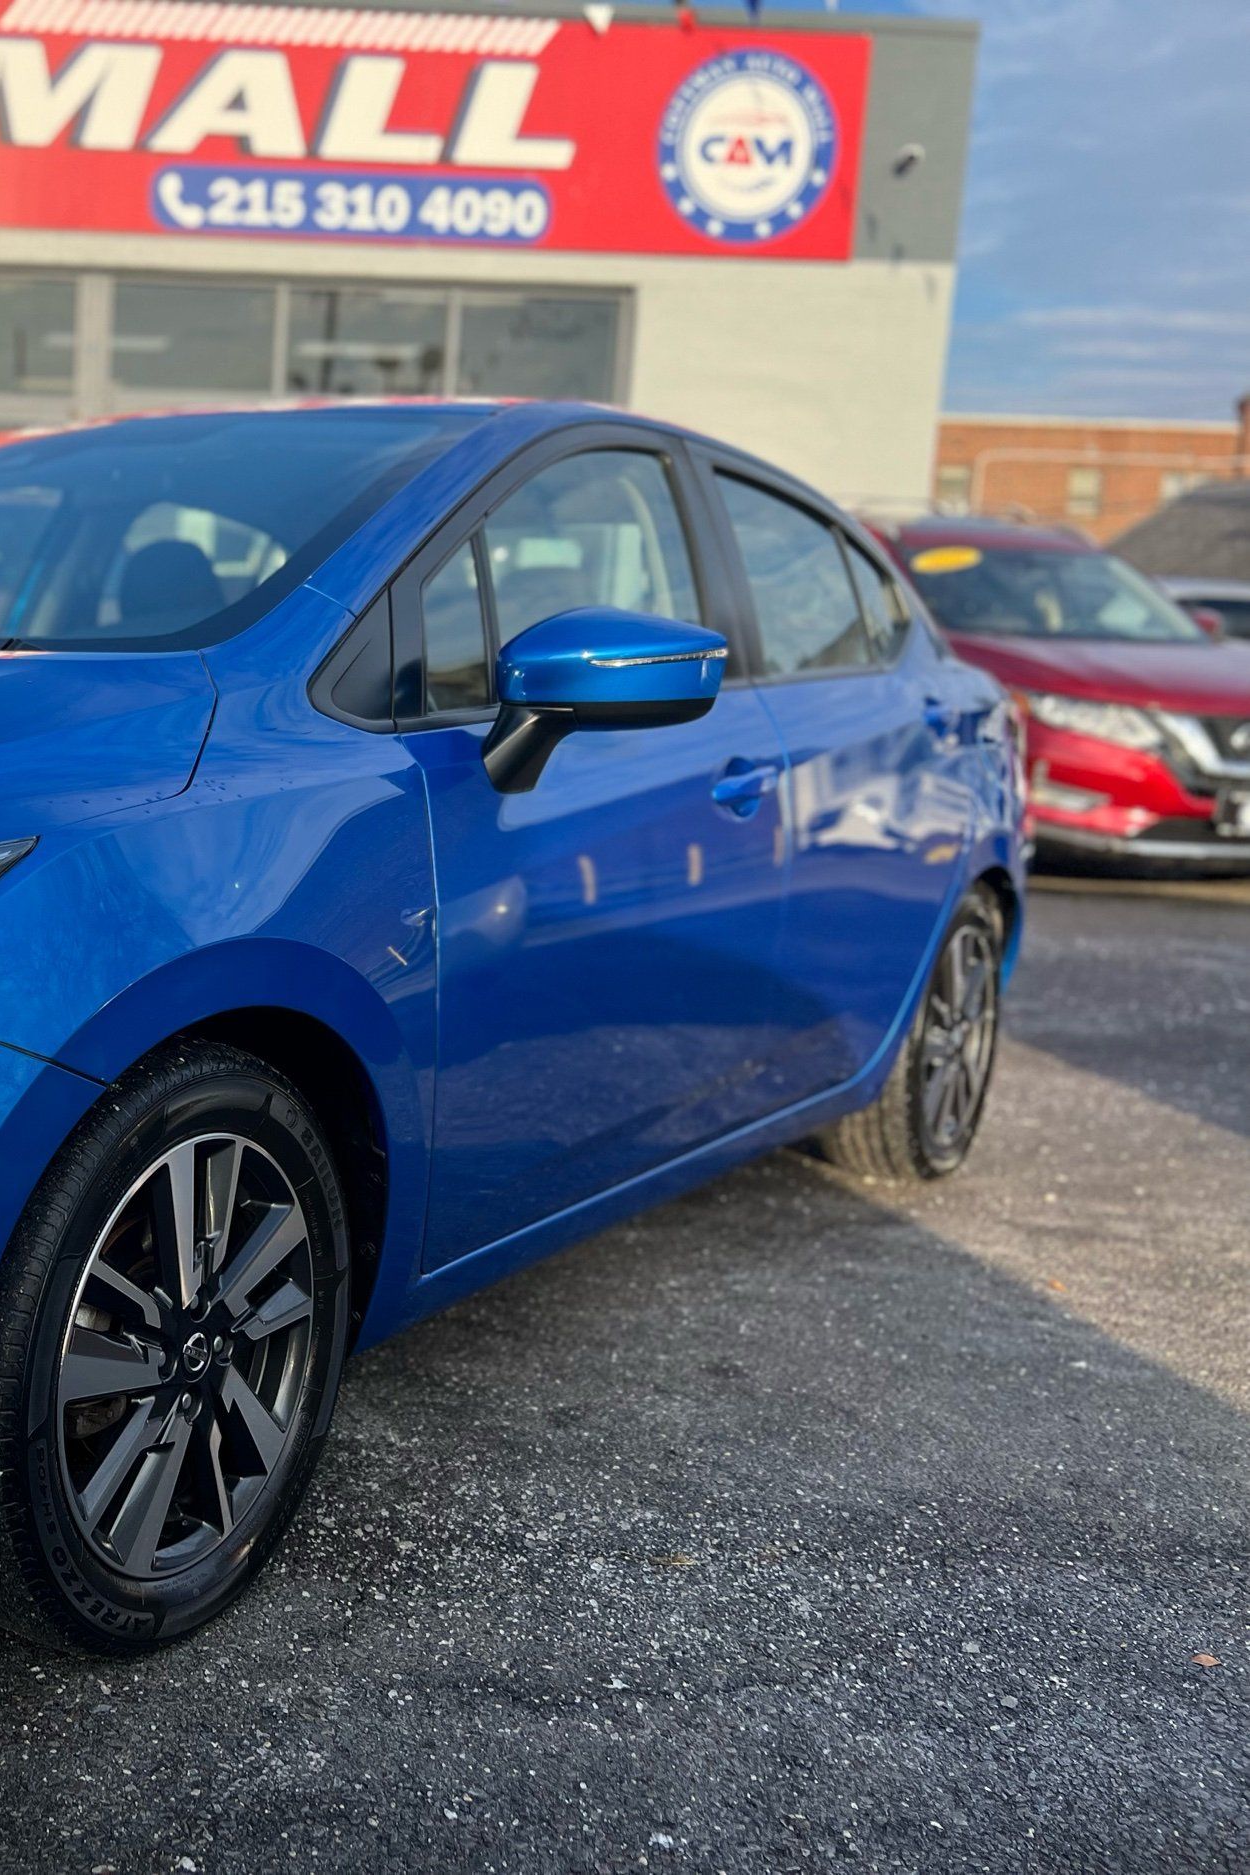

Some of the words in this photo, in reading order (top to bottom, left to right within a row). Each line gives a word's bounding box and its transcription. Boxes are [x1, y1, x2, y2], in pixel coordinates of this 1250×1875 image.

[699, 135, 794, 167] CAM
[207, 177, 307, 229] 215
[313, 181, 411, 233] 310
[418, 186, 549, 238] 4090
[51, 1546, 151, 1634] ATREZZO
